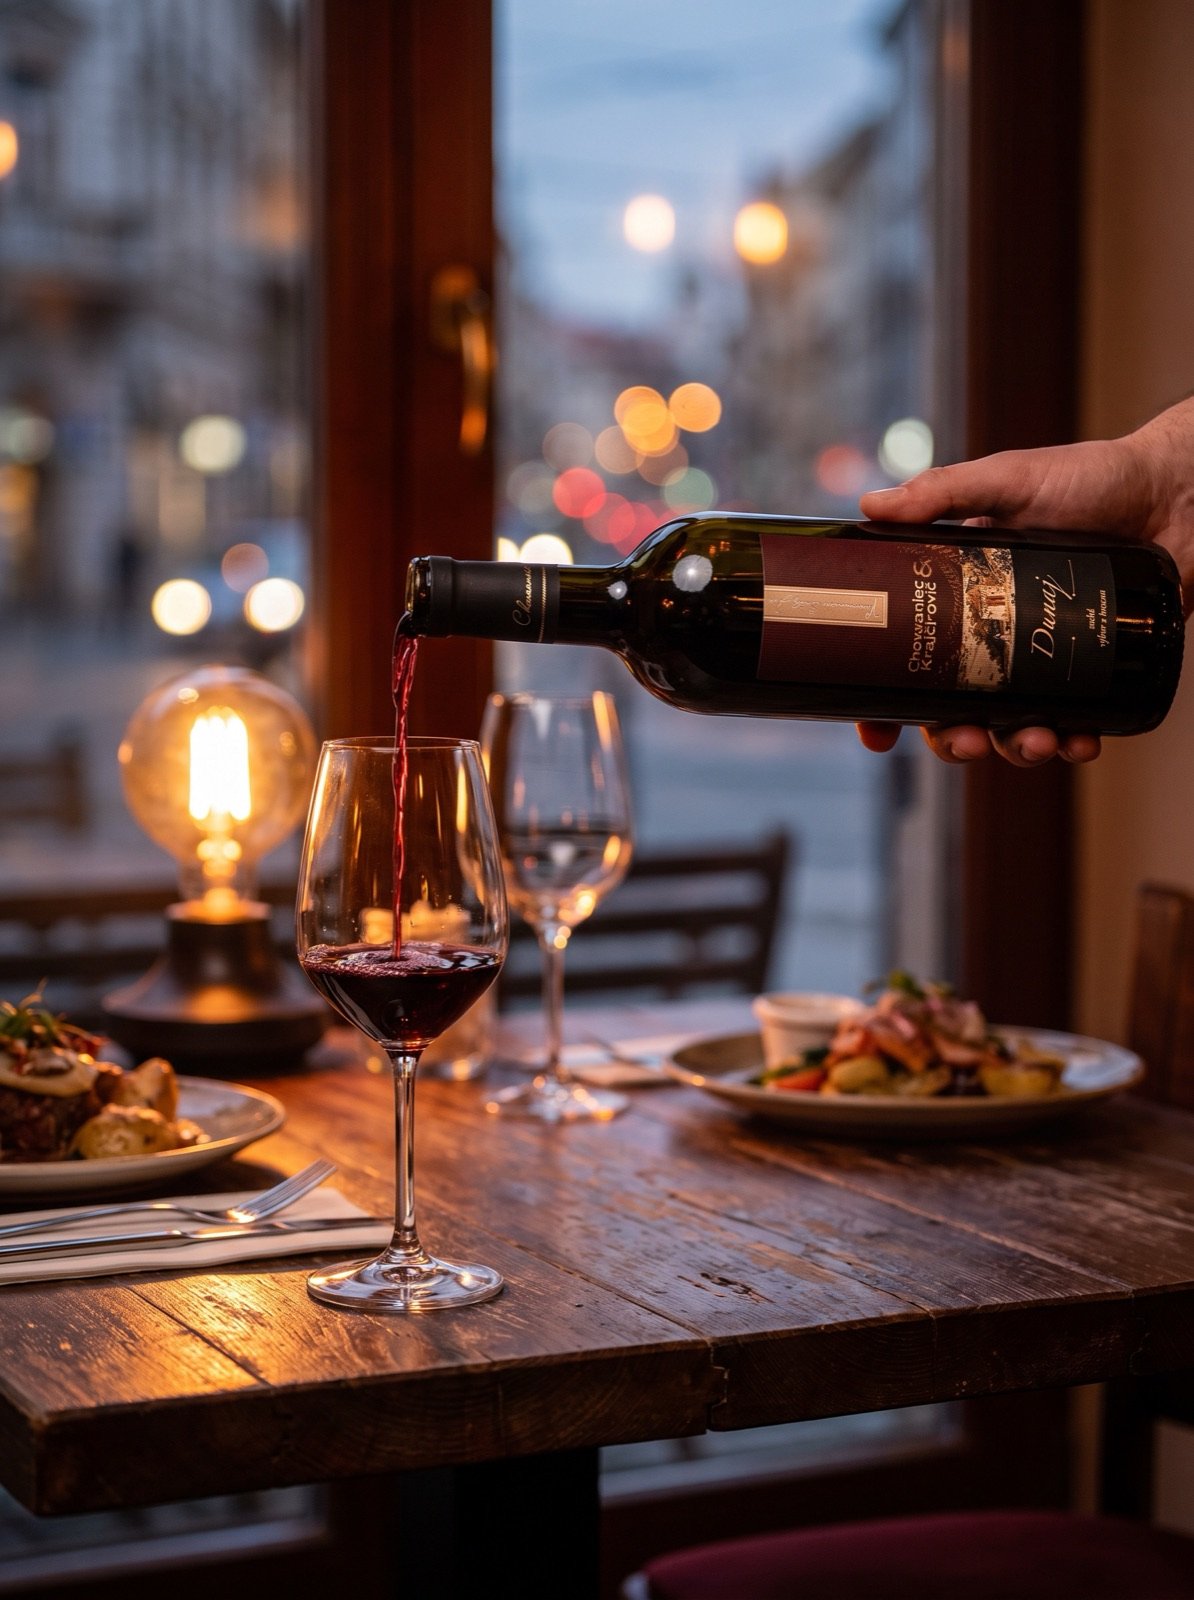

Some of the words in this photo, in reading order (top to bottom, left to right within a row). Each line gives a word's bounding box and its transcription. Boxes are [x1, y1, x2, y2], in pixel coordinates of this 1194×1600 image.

[913, 560, 933, 578] &
[908, 580, 925, 673] Chowaniec
[920, 581, 937, 671] Krajčirovič
[1030, 574, 1073, 659] Dunaj
